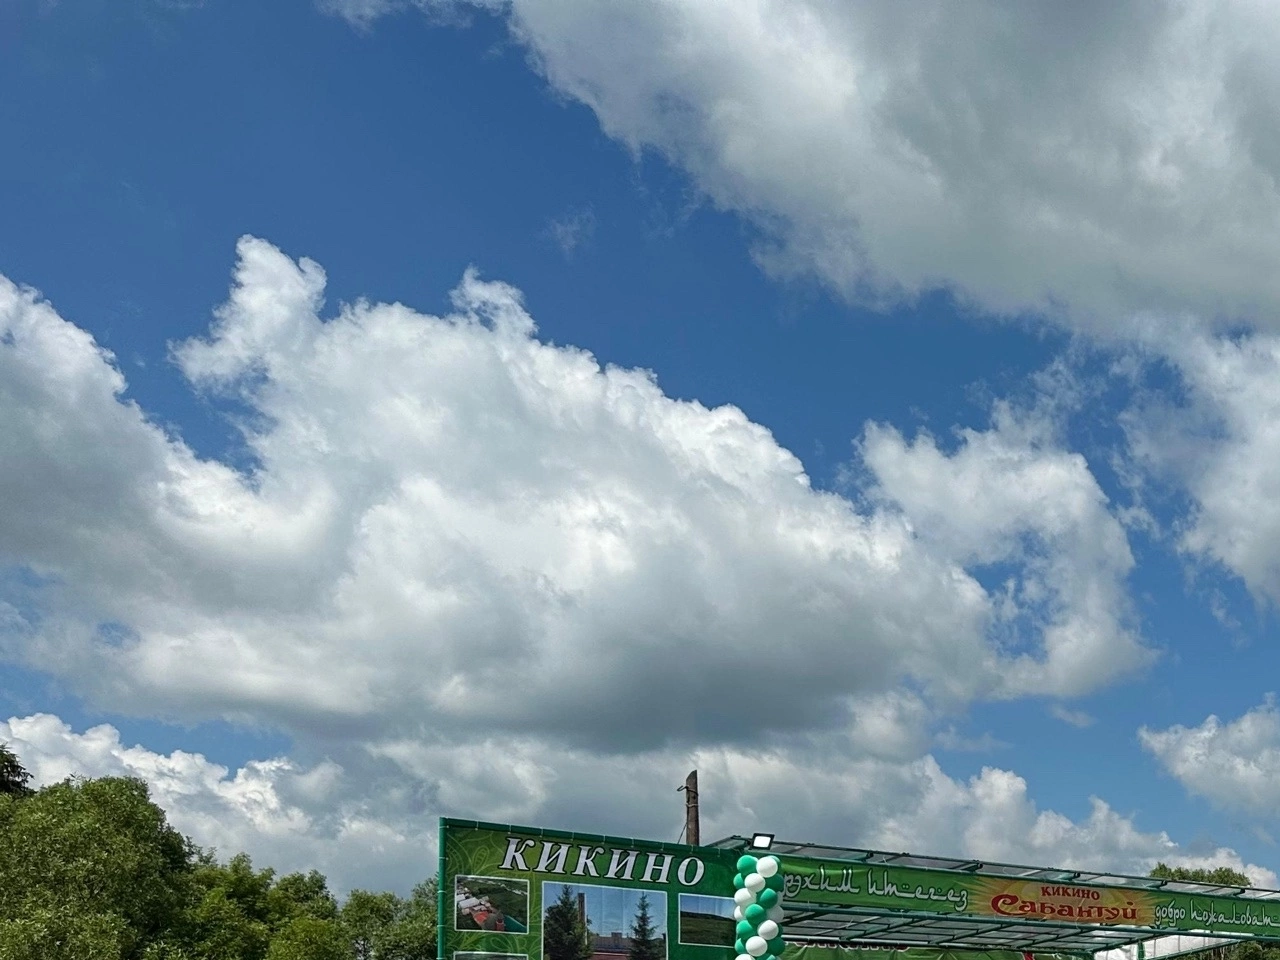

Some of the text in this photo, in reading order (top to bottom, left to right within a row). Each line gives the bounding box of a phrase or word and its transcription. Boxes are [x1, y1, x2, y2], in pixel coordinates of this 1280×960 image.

[498, 837, 705, 886] КИКИНО
[990, 893, 1138, 920] Сабантуй
[1155, 899, 1186, 926] добро
